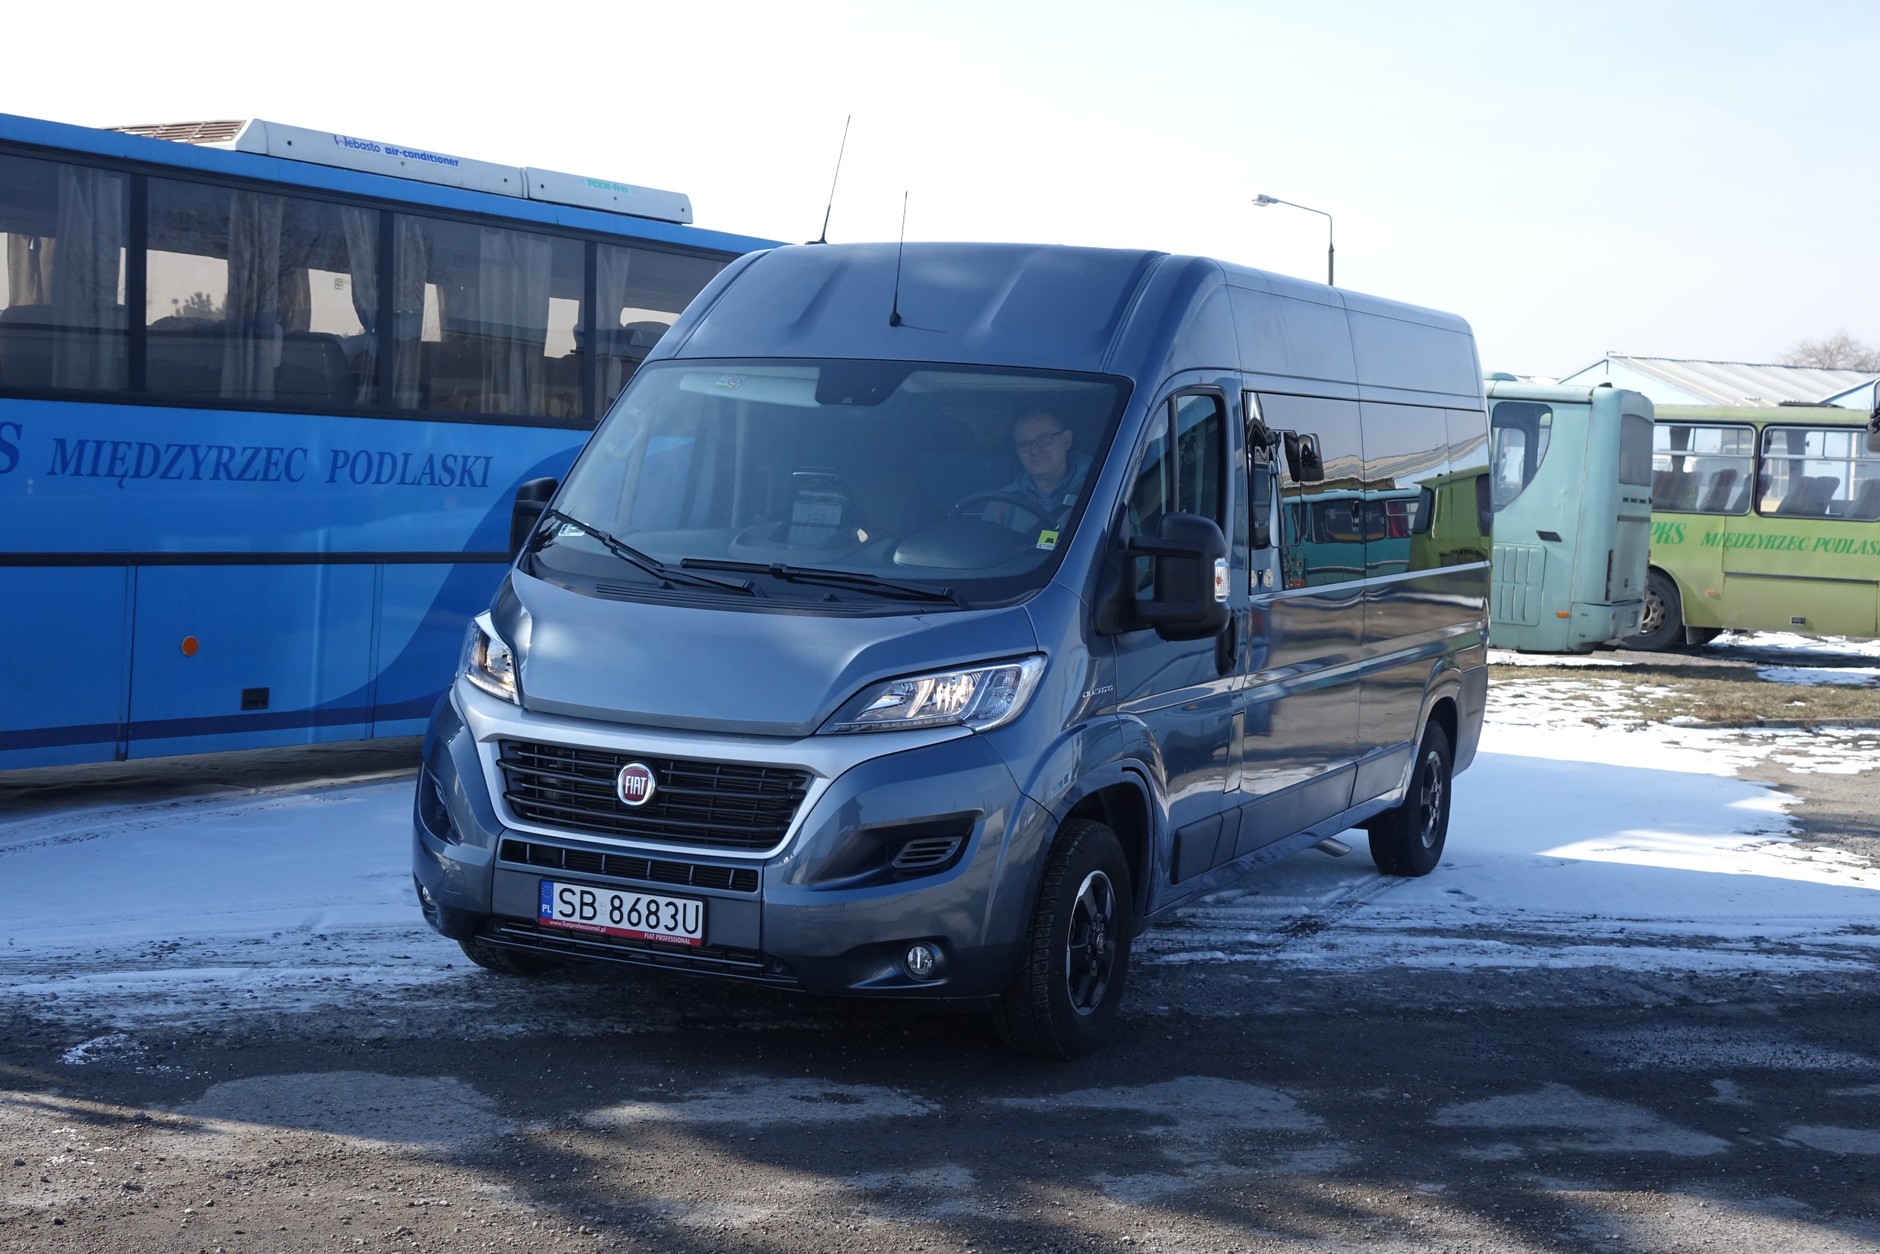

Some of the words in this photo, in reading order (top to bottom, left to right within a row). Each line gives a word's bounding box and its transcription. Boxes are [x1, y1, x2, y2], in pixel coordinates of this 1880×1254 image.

[385, 146, 460, 167] air-conditioner
[46, 438, 308, 489] MIĘDZYRZEC
[325, 449, 493, 488] PODLASKI
[1700, 531, 1811, 552] MIĘDZYRZEC
[1812, 536, 1880, 556] PODLAS
[625, 775, 648, 796] FIAT
[542, 903, 552, 914] PL
[558, 887, 598, 921] SB
[609, 894, 700, 935] 8683U
[549, 920, 607, 933] www.fiatprofessional.pl
[644, 932, 656, 941] FIAT
[656, 933, 691, 945] PROFESSIONAL
